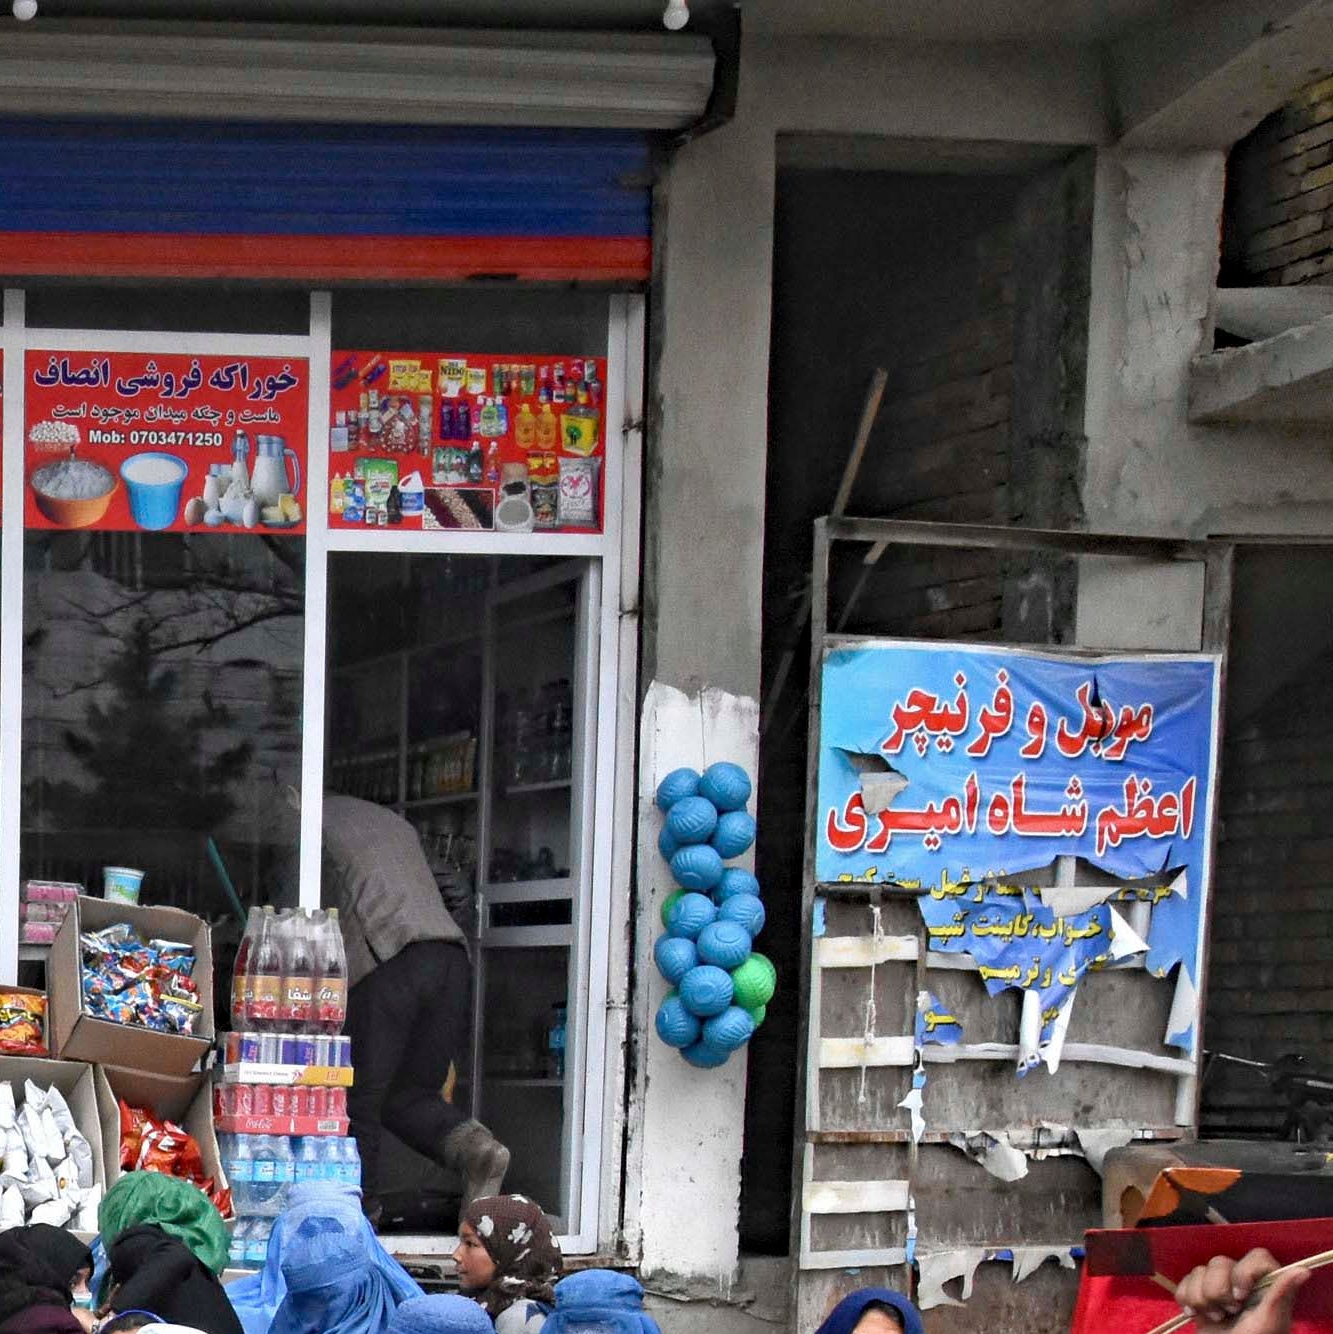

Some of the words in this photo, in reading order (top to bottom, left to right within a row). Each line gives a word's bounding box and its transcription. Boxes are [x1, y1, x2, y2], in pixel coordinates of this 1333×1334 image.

[34, 357, 110, 387] انصاف
[116, 360, 202, 397] فروشی
[208, 361, 298, 399] خوراکه
[52, 403, 86, 419] است
[91, 404, 140, 424] موجود
[145, 405, 187, 424] میدان
[226, 410, 234, 424] و
[240, 407, 280, 423] ماست
[89, 430, 125, 444] Mob:
[129, 431, 222, 446] 0703471250
[882, 669, 1014, 757] فرنیچر
[1021, 701, 1047, 759] و
[987, 772, 1088, 837] شاه
[1097, 772, 1197, 856] اعظم
